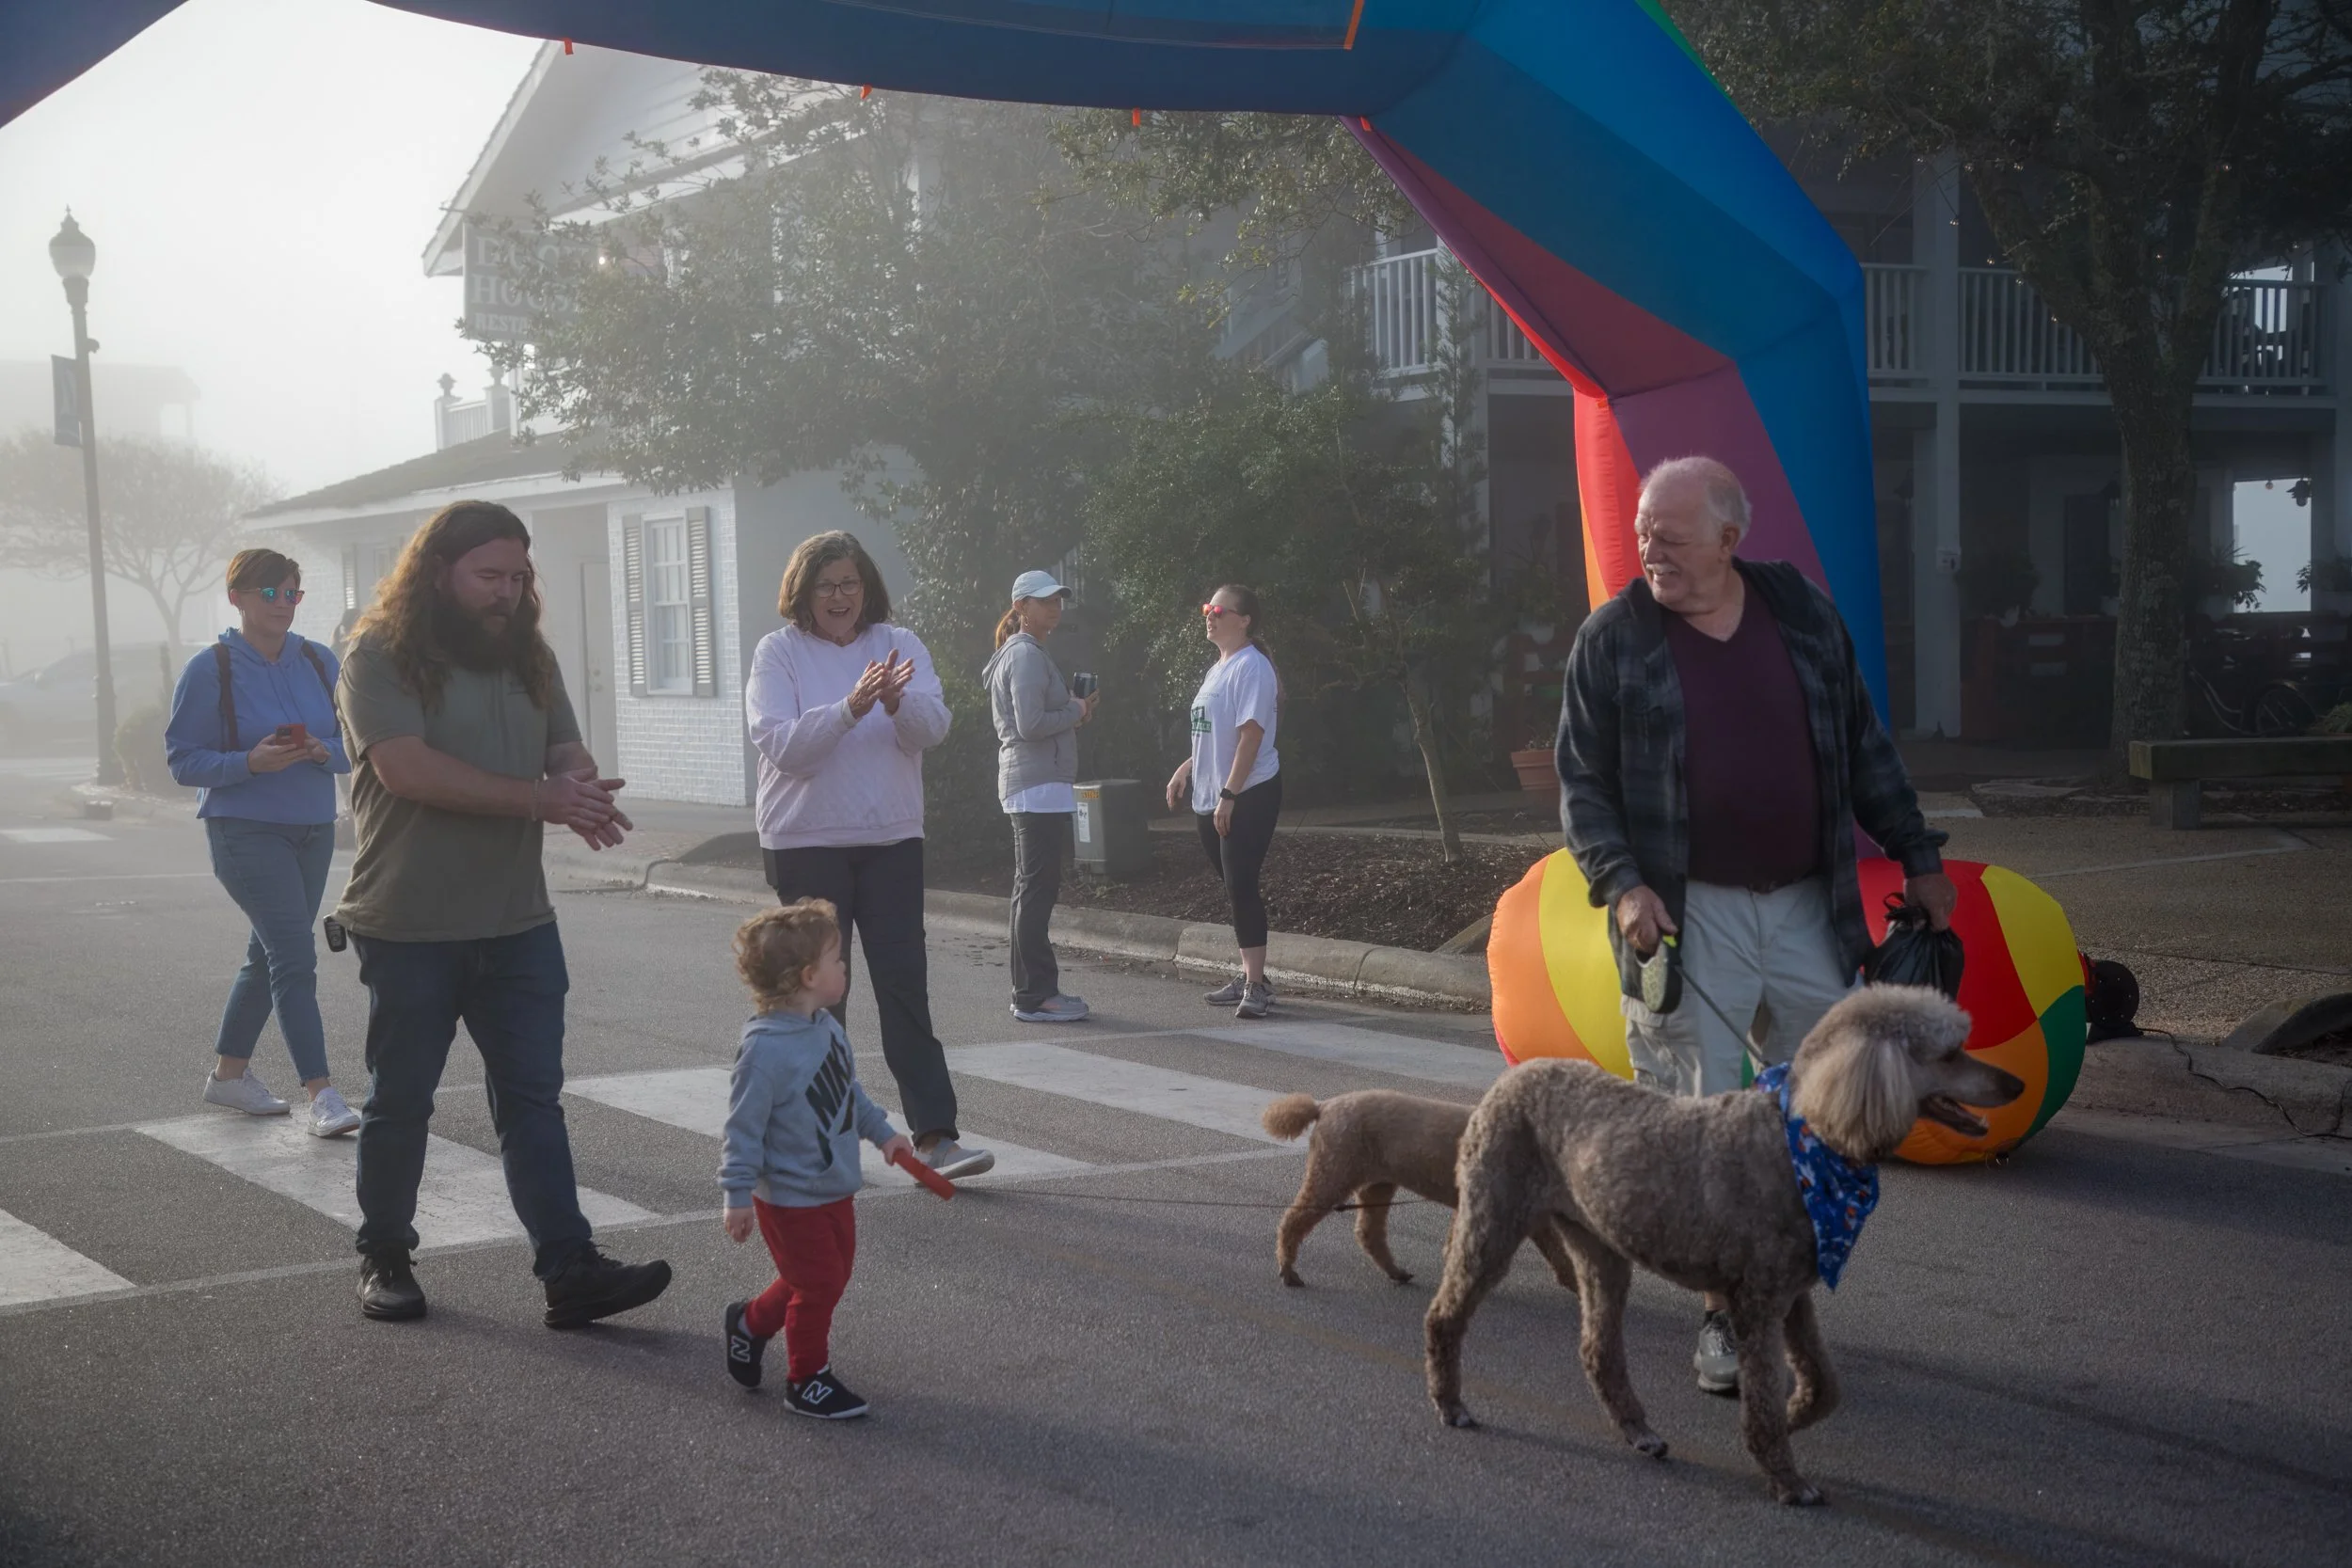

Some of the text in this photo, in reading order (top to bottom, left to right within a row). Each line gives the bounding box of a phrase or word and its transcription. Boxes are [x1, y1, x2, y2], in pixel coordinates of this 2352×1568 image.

[470, 273, 578, 311] HOUS
[730, 1335, 751, 1363] N
[802, 1380, 833, 1404] N
